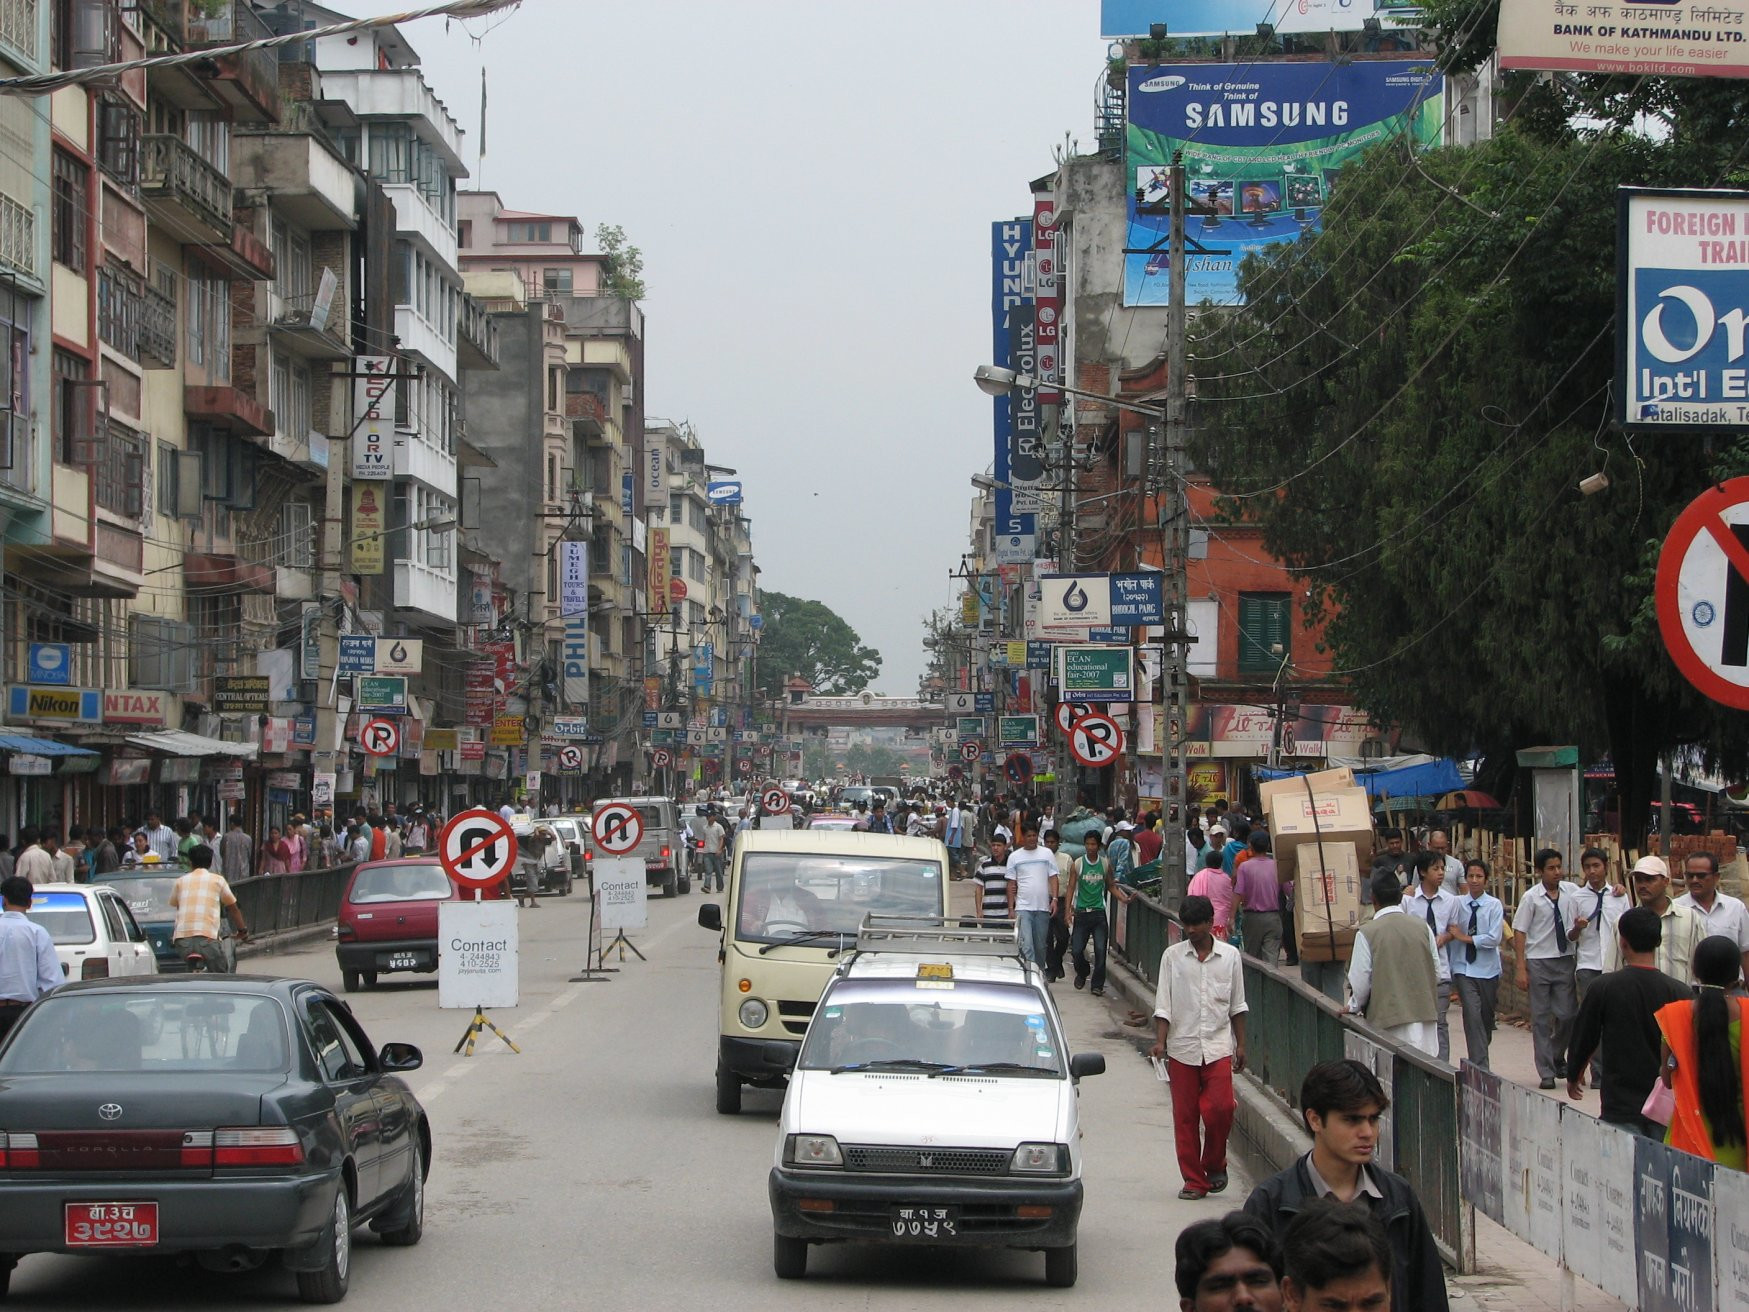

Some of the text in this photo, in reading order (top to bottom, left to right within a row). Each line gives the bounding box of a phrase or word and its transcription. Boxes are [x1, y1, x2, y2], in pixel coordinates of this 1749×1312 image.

[1690, 5, 1744, 24] लिमिटेड
[1553, 24, 1747, 42] BANK OF KATHMANDU LTD.
[1570, 40, 1728, 59] We make your life easier
[1597, 61, 1696, 74] www.bokltd.com
[1144, 80, 1181, 88] SAMSUNG
[1188, 82, 1260, 91] Think of Genuine
[1223, 92, 1258, 100] Think of
[1185, 101, 1348, 128] SAMSUNG
[1347, 130, 1381, 147] MONITORS
[1646, 210, 1737, 236] FOREIGN
[1038, 230, 1054, 240] LG
[1039, 278, 1054, 288] LG
[1039, 326, 1055, 336] LG
[1642, 368, 1749, 399] Int'l E
[1640, 406, 1731, 424] utalisadak,
[363, 454, 383, 463] TV
[651, 448, 661, 488] ocean
[568, 542, 580, 580] SUMEGH
[565, 618, 586, 678] PHIL
[1067, 655, 1091, 663] ECAN
[1067, 663, 1108, 671] educational
[216, 692, 243, 700] CENTRAL
[30, 694, 79, 713] Nikon
[105, 695, 160, 713] NTAX
[555, 724, 585, 734] Orbit
[1300, 743, 1321, 754] Walk
[601, 881, 638, 890] Contact
[451, 938, 507, 951] Contact
[893, 1221, 956, 1237] ७७५९
